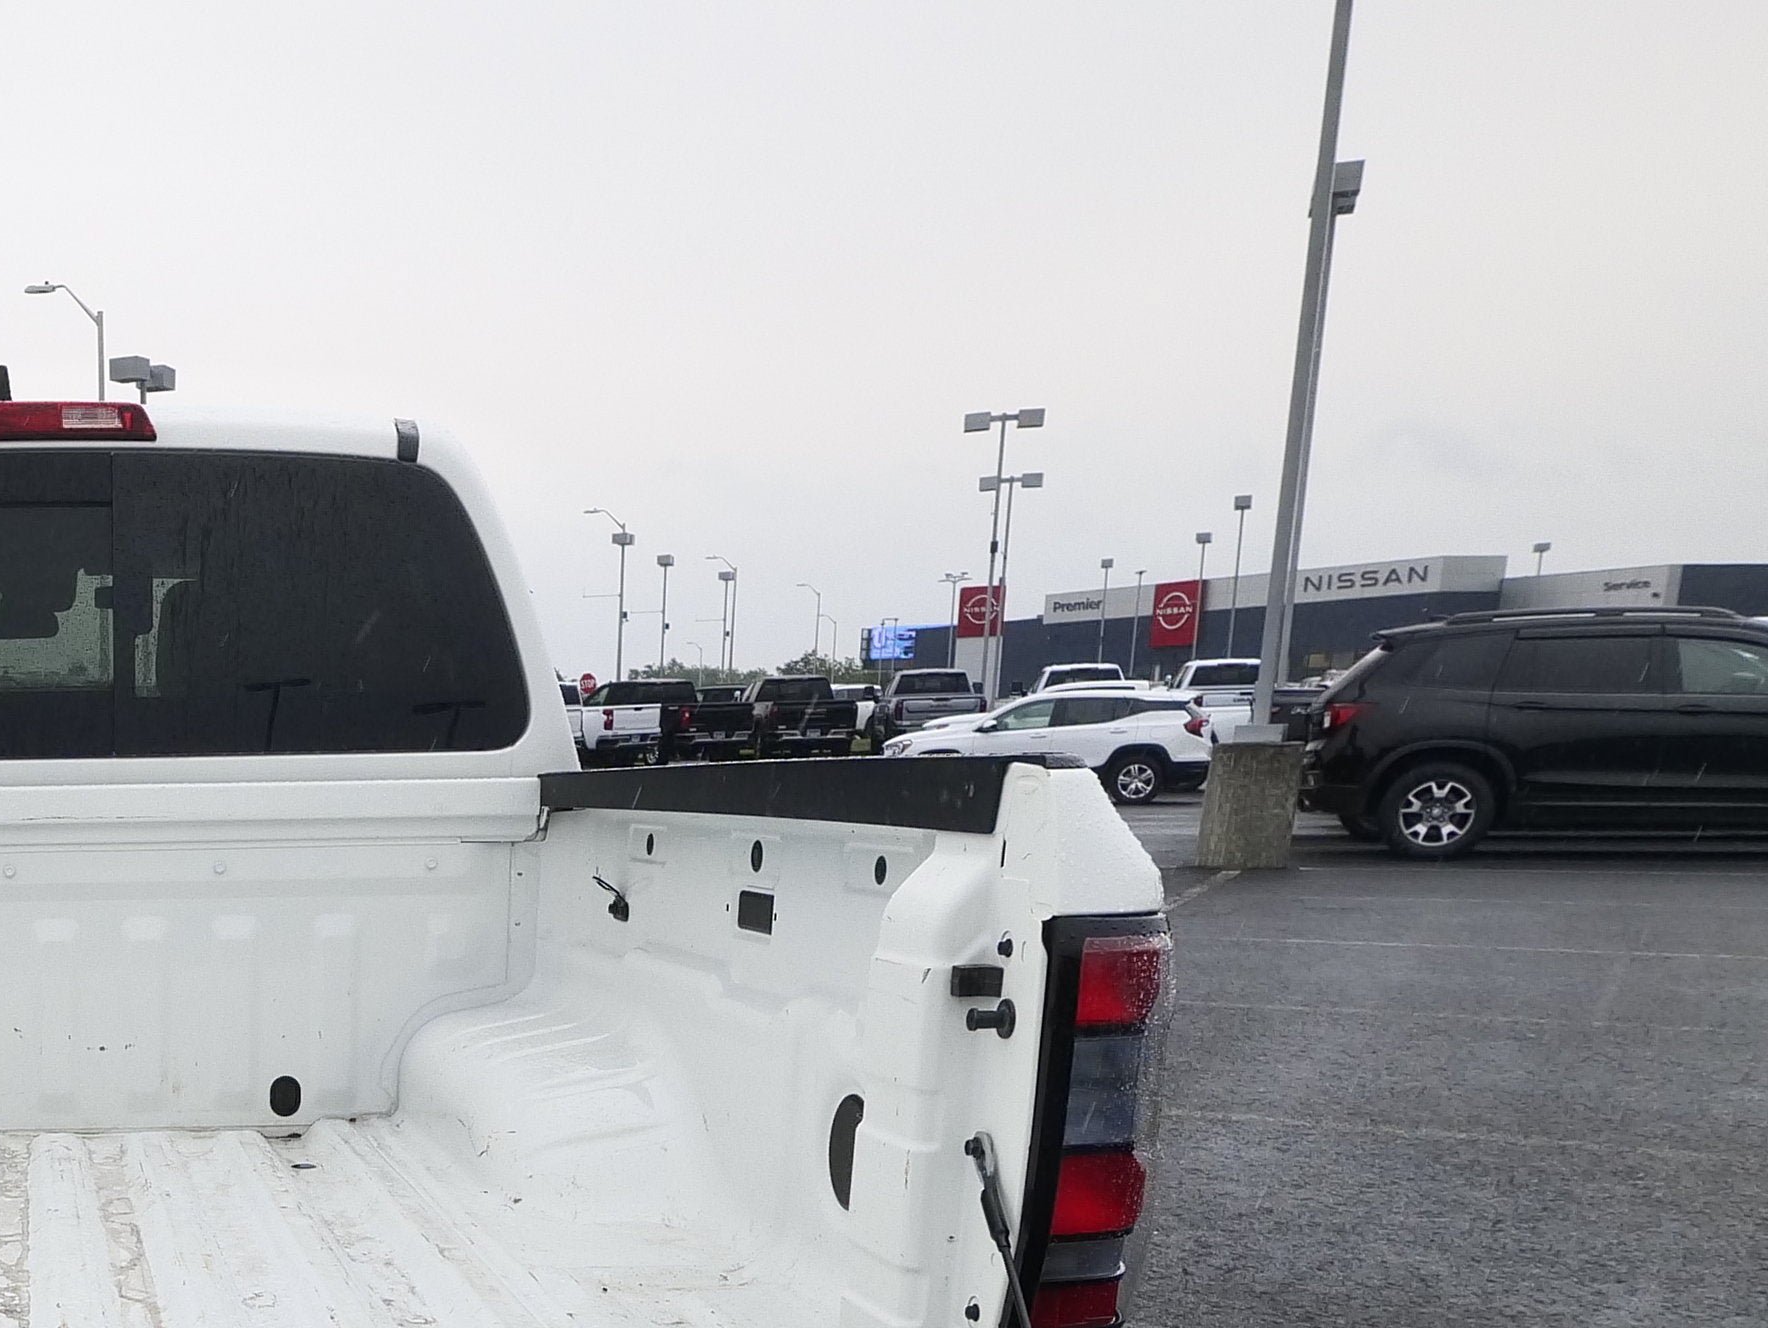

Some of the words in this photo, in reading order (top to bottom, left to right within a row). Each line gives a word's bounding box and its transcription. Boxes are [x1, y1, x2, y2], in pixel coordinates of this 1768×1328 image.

[1303, 565, 1429, 593] NISSAN
[1053, 597, 1103, 613] Premier
[1156, 605, 1193, 616] NISSAN
